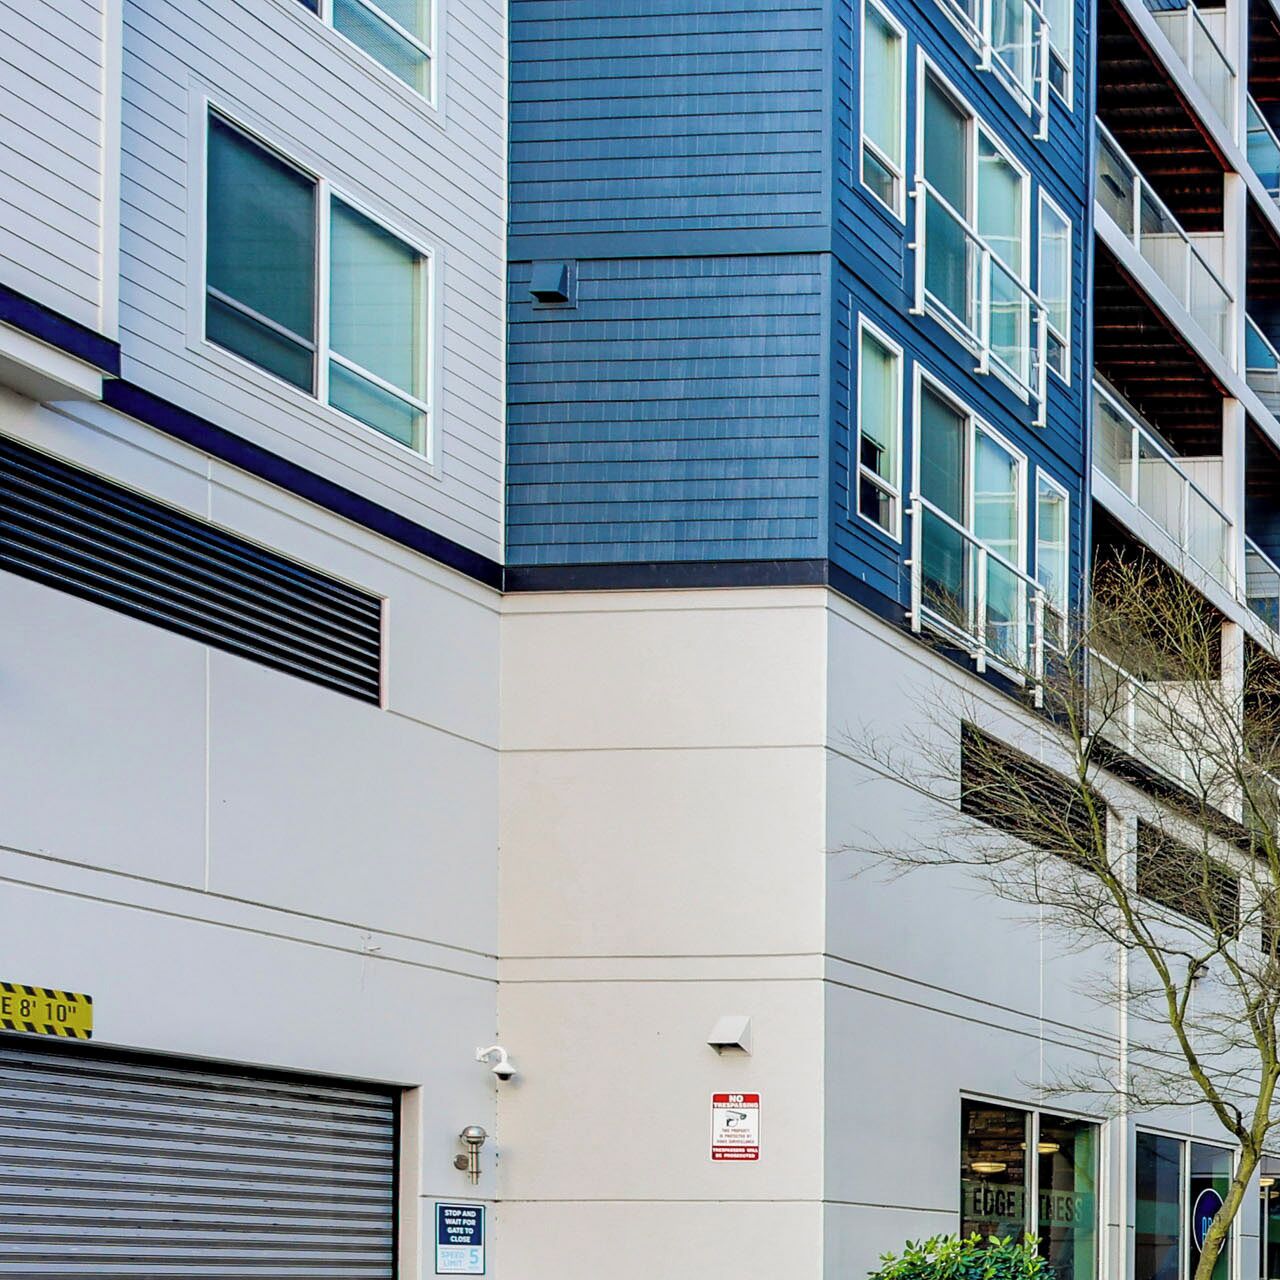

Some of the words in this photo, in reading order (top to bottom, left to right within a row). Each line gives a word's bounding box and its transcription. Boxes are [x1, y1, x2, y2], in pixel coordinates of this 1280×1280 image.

[20, 999, 36, 1018] 8'
[46, 1003, 76, 1022] 10"
[728, 1095, 744, 1103] NO
[973, 1187, 1015, 1217] EDGE
[1021, 1191, 1083, 1222] TNESS
[444, 1209, 461, 1217] STOP
[450, 1235, 471, 1243] CLOSE
[470, 1249, 480, 1264] 5
